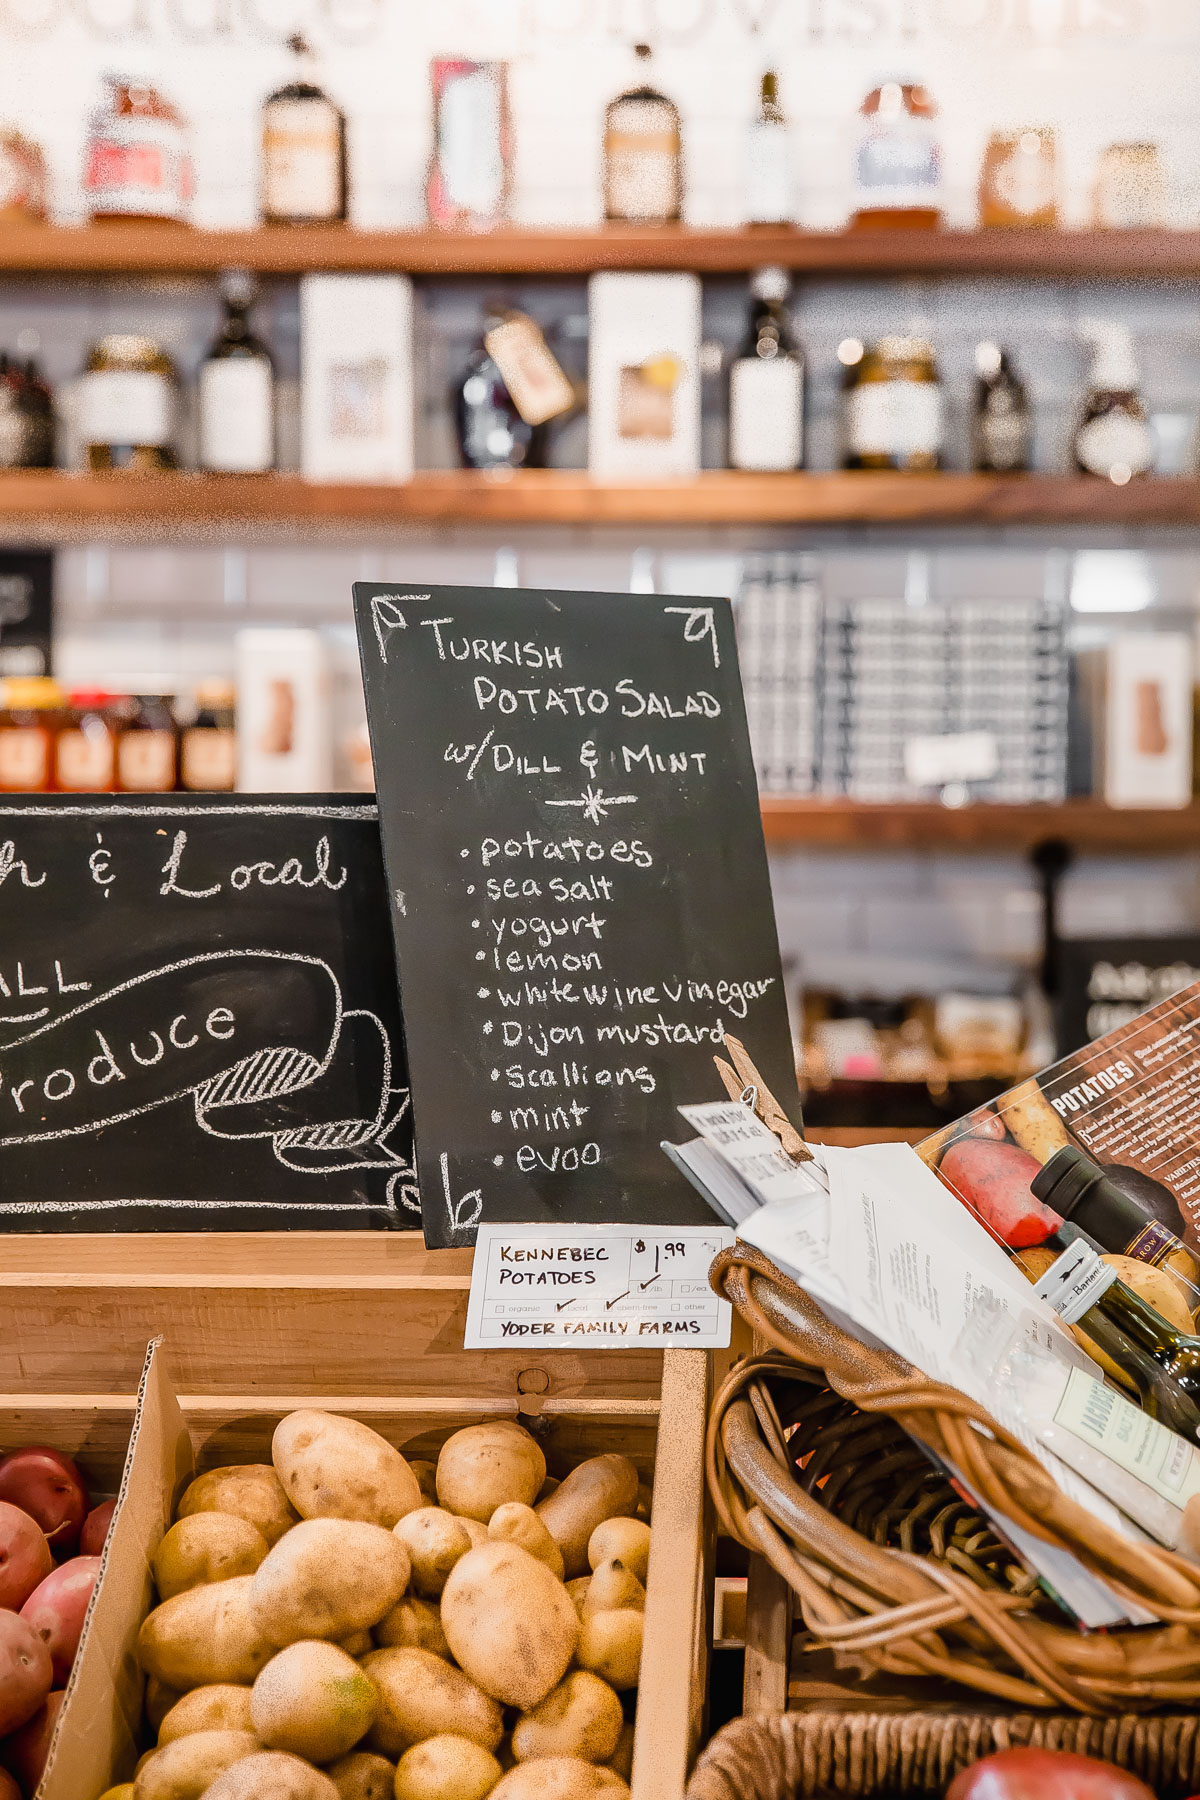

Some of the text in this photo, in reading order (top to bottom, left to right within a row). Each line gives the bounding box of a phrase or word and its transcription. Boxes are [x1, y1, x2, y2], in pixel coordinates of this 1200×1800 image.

[420, 617, 564, 669] TURKISH
[473, 676, 721, 718] POTATO SALAD
[579, 740, 600, 779] &
[621, 744, 707, 776] MINT
[160, 830, 347, 898] Local
[480, 831, 654, 867] potatoes
[486, 875, 614, 901] sea salt
[491, 912, 606, 947] yogurt
[493, 948, 602, 972] lemon
[662, 978, 775, 1019] vinegar
[502, 1014, 726, 1056] Dijon mustard
[0, 1007, 236, 1113] roduce
[506, 1062, 656, 1093] scallions
[1051, 1060, 1134, 1118] POTATOES
[509, 1099, 591, 1131] mint
[516, 1142, 600, 1172] evoo
[501, 1246, 610, 1263] KENNEBEC
[500, 1269, 596, 1285] POTATOES
[508, 1304, 541, 1313] organic
[684, 1303, 706, 1311] other
[501, 1320, 701, 1336] YODER FAMILY FARMS
